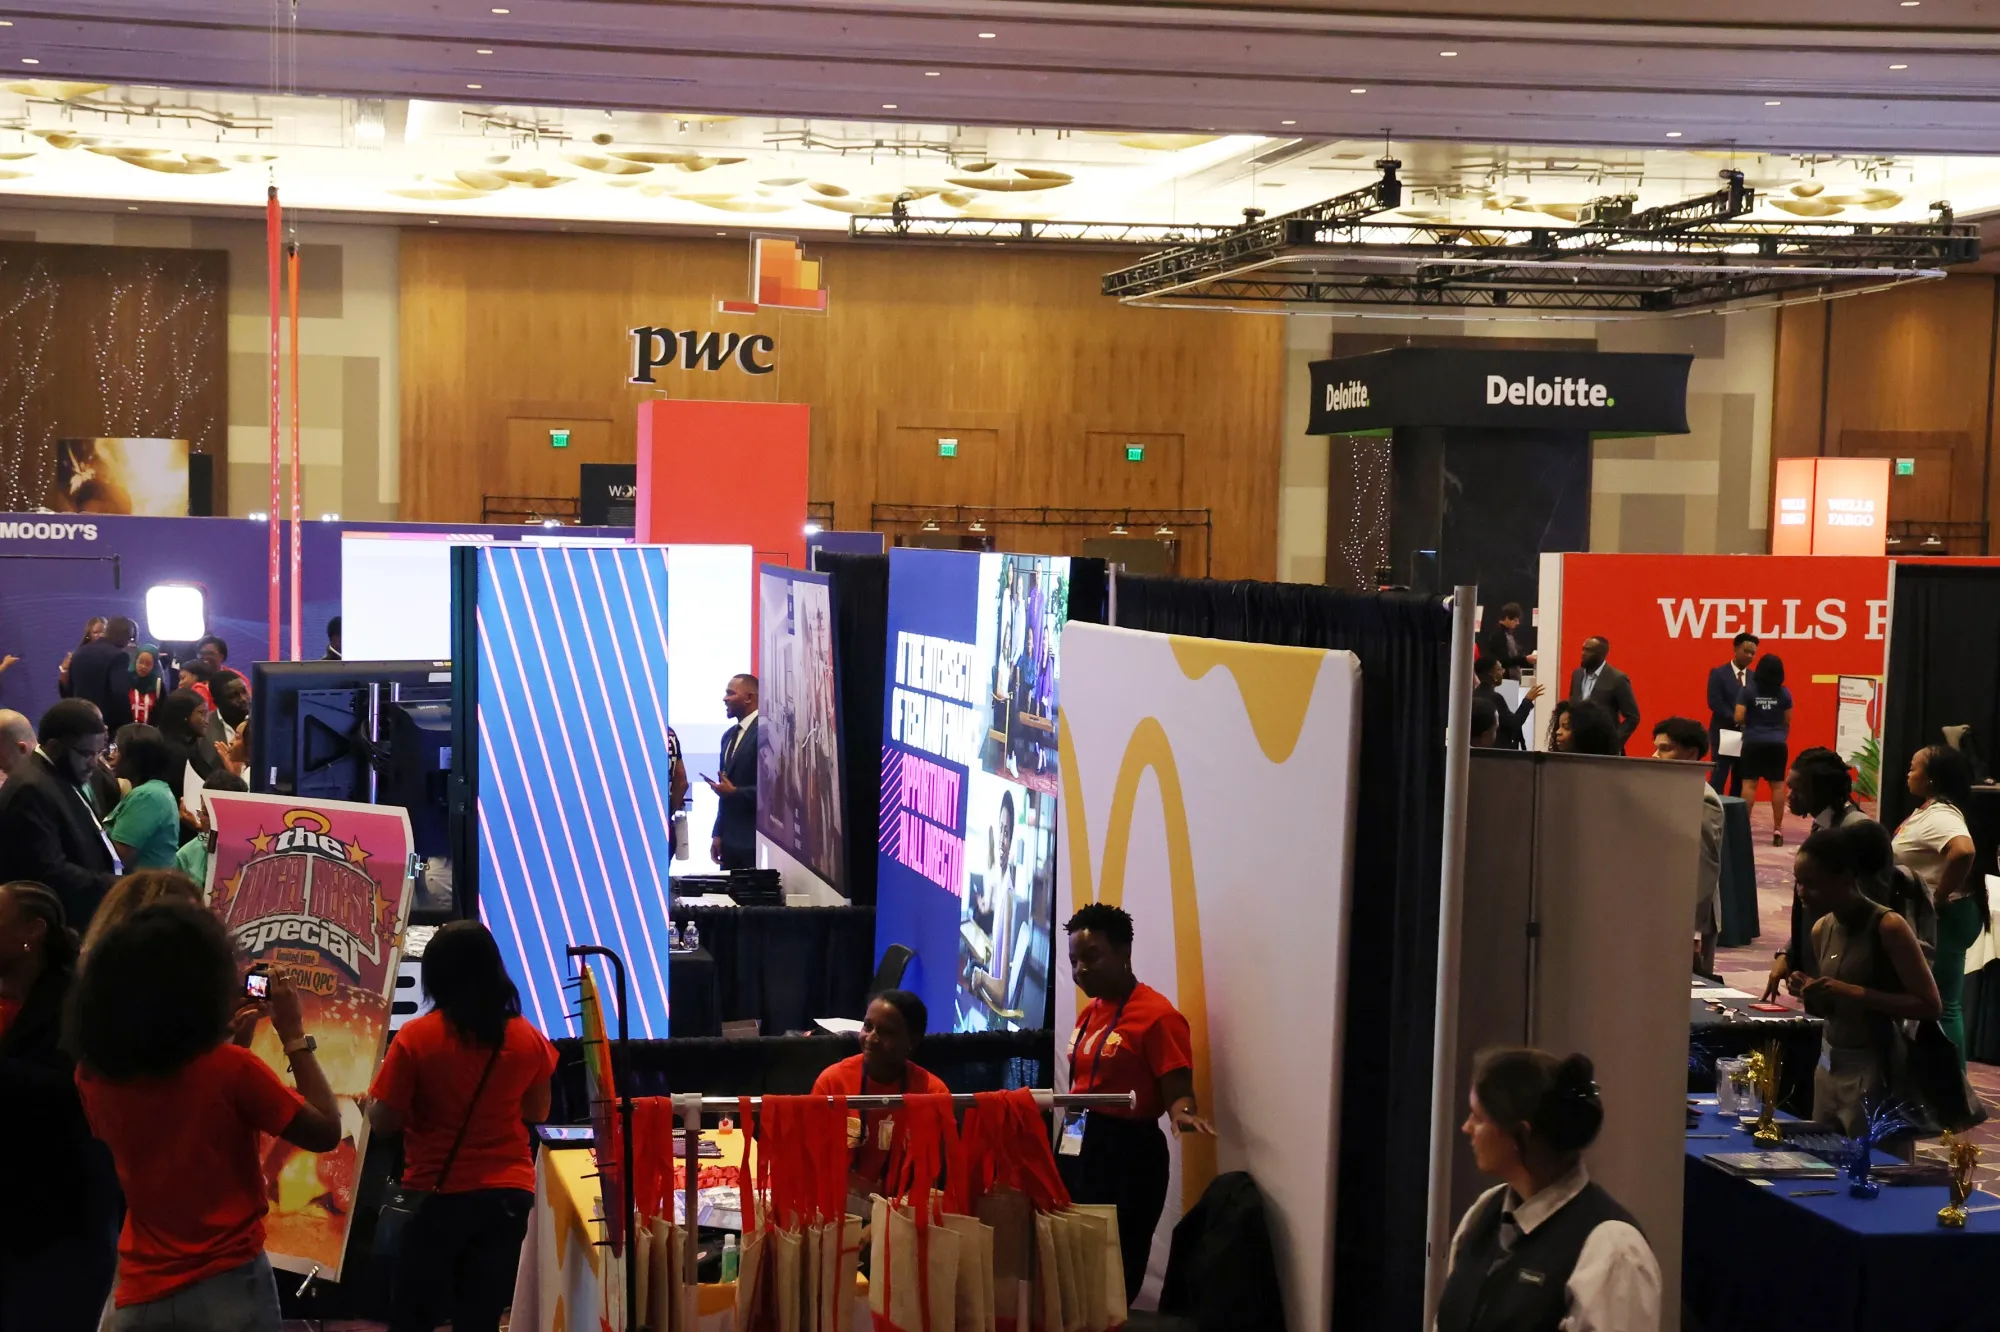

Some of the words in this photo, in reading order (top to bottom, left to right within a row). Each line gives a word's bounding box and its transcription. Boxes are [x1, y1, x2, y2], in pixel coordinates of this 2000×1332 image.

[628, 326, 774, 384] pwc
[0, 522, 98, 541] MOODY'S
[1656, 597, 1847, 641] WELLS
[901, 752, 961, 830] OPPORTUNITY
[276, 827, 345, 859] the
[899, 809, 909, 867] IN
[908, 814, 923, 875] ALL
[238, 919, 360, 976] special
